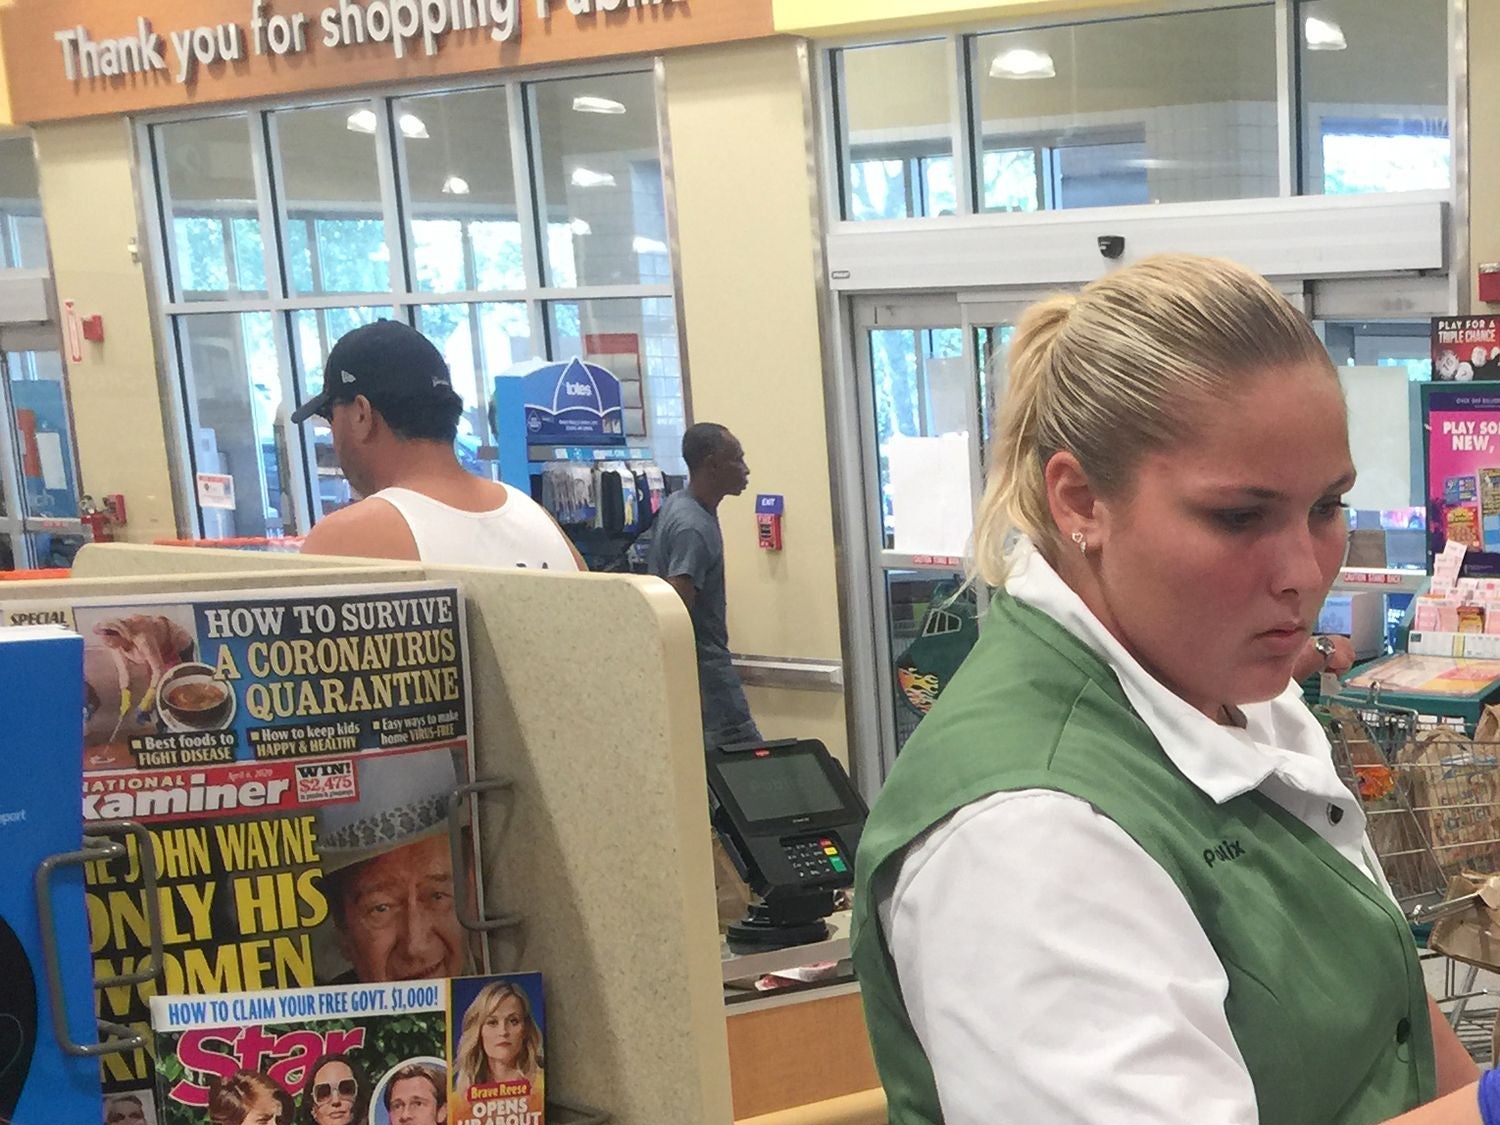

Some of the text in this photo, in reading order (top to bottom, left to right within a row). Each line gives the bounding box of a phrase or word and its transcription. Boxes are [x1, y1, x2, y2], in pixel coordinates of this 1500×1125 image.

[54, 0, 515, 84] Thank you for shopping
[1438, 319, 1496, 330] PLAY FOR A
[1452, 434, 1494, 454] NEW,
[11, 611, 68, 627] SPECIAL
[204, 596, 453, 638] HOW TO SURVIVE
[212, 628, 456, 680] A CORONAVIRUS
[246, 666, 460, 722] QUARANTINE
[145, 733, 234, 750] Best foods to
[262, 721, 361, 742] How to keep kids
[381, 724, 455, 746] home VIRUS-FREE
[139, 747, 233, 766] FIGHT DISEASE
[256, 735, 357, 758] HAPPY & HEALTHY
[297, 762, 352, 778] WIN!
[299, 775, 352, 794] $2,475
[124, 826, 212, 883] JOHN
[215, 816, 320, 872] WAYNE
[168, 985, 439, 1026] HOW TO CLAIM YOUR FREE GOVT. $1,000!
[169, 1024, 366, 1107] Star
[470, 1083, 528, 1099] Brave Reese
[472, 1096, 528, 1118] OPENS
